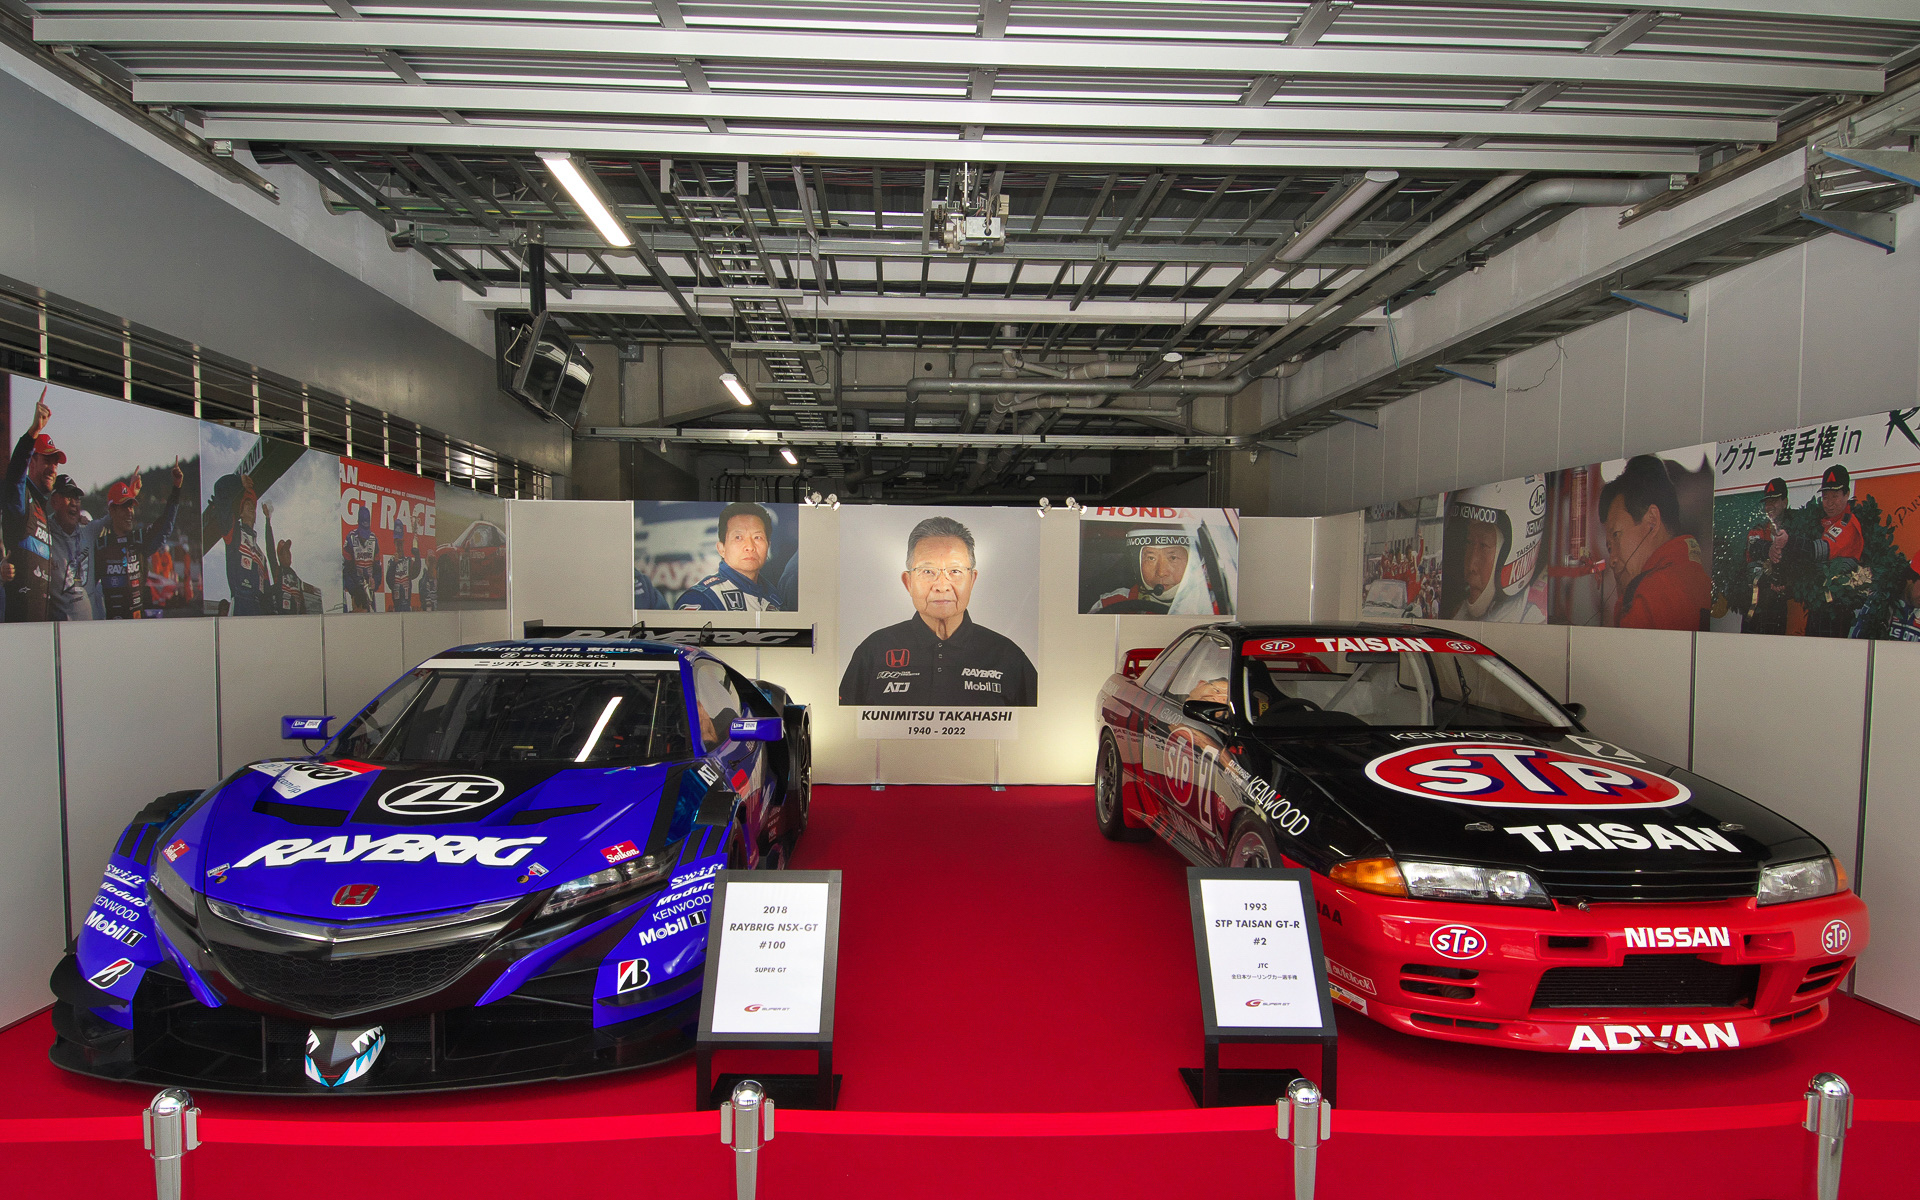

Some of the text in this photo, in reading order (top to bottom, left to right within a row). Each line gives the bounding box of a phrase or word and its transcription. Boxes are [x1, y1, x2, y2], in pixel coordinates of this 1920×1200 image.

[1839, 425, 1862, 455] in
[341, 487, 436, 537] GT RACE
[1460, 506, 1497, 524] KENWOOD
[1262, 640, 1292, 651] STP
[1315, 638, 1435, 652] TAISAN
[961, 667, 1003, 680] RAYBRIG
[883, 681, 911, 694] ATJ
[964, 681, 992, 692] Mobil
[861, 710, 1013, 721] KUNIMITSU TAKAHASHI
[908, 726, 932, 735] 1940
[942, 727, 966, 735] 2022
[1391, 731, 1525, 742] KENWOOD
[1166, 735, 1190, 790] STP
[1406, 747, 1646, 797] STP
[388, 781, 480, 806] ZF
[1245, 775, 1310, 836] KENWOOD
[1503, 823, 1742, 853] TAISAN
[232, 834, 548, 868] RAYBRIG
[671, 863, 724, 887] Swift
[652, 894, 711, 922] KENWOOD
[763, 906, 788, 914] 2018
[1244, 903, 1267, 911] 1993
[85, 910, 145, 947] Mobil 1
[639, 910, 706, 946] Mobil 1
[729, 923, 818, 932] RAYBRIG NSX-GT
[1215, 919, 1300, 929] STP TAISAN GT-R
[759, 941, 786, 950] #100
[1253, 937, 1267, 946] #2
[1436, 929, 1480, 955] STP
[1624, 926, 1730, 948] NISSAN
[1825, 923, 1848, 951] STP
[1568, 1022, 1740, 1051] ADVAN
